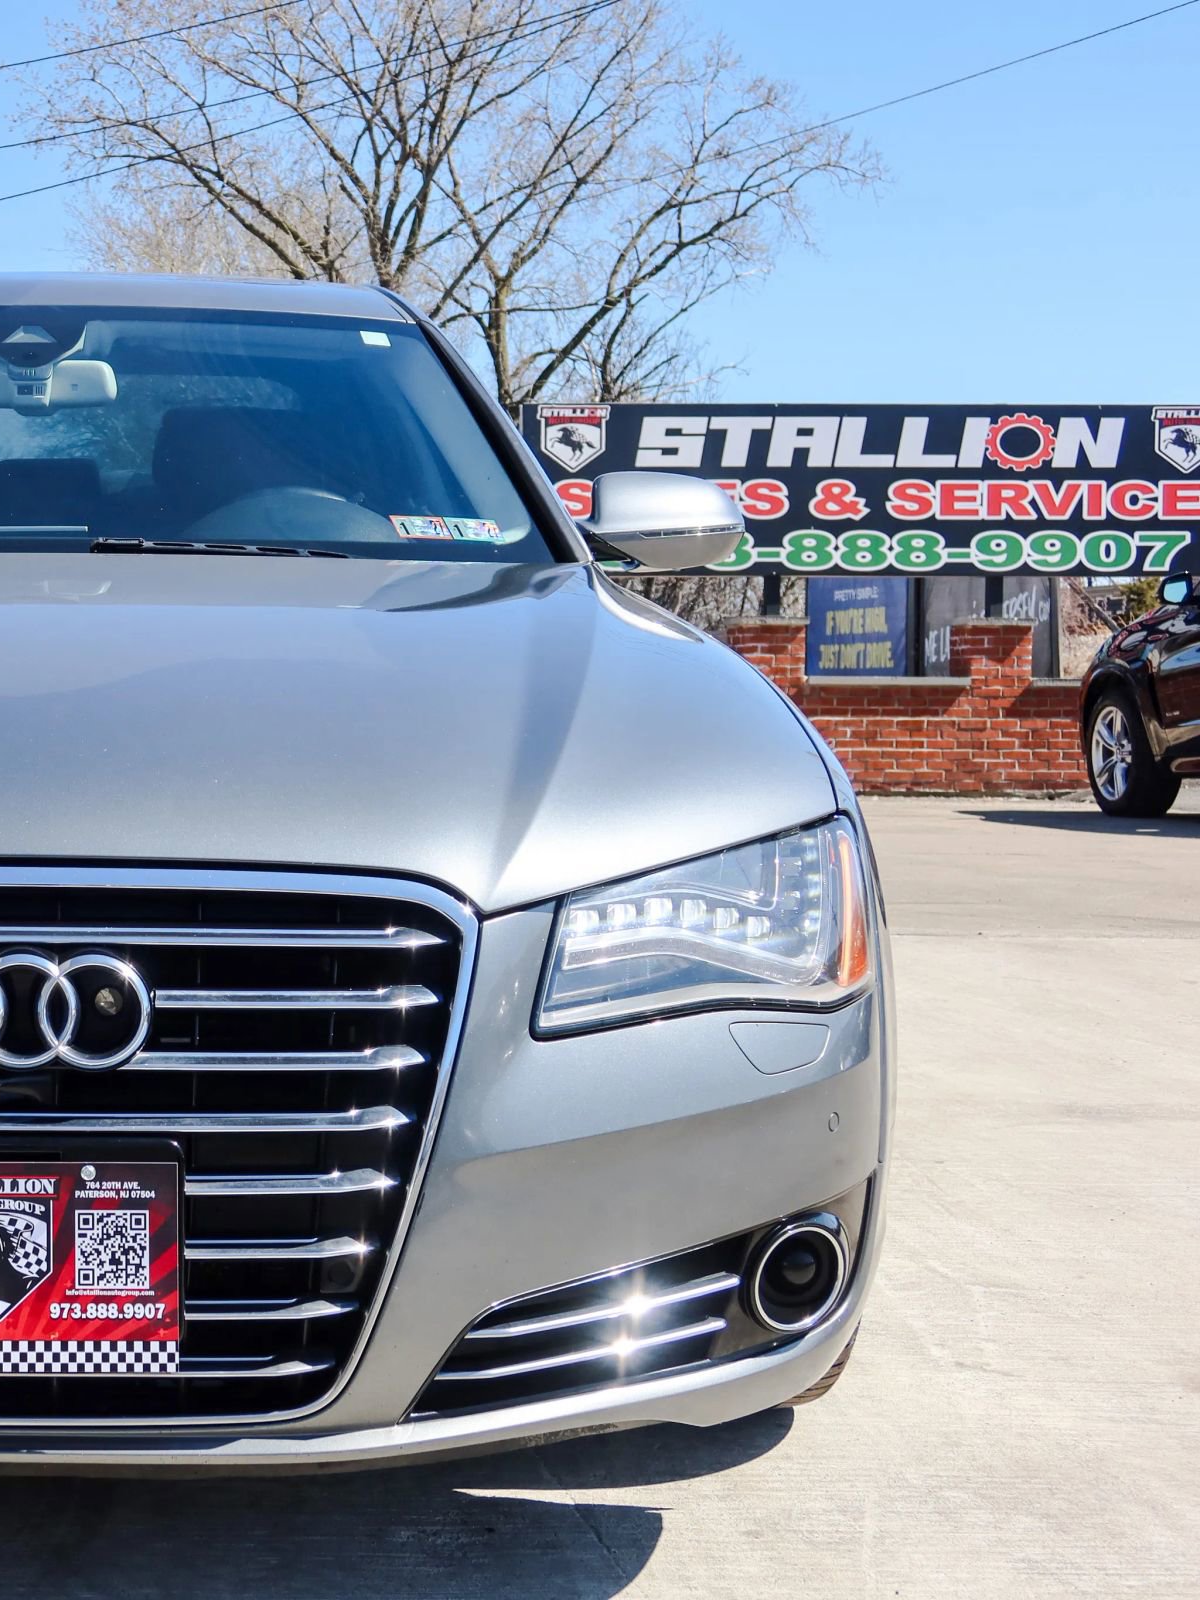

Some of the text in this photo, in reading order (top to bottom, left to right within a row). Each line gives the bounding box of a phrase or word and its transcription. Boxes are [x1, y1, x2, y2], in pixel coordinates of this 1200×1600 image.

[541, 408, 607, 417] STALLION
[635, 412, 1126, 472] STALLION
[808, 478, 871, 521] &
[885, 479, 1200, 521] SERVICE
[85, 1181, 140, 1190] 764 20TH AVE.
[74, 1190, 155, 1200] PATERSON, NJ 07504
[49, 1302, 166, 1319] 973.888.9907
